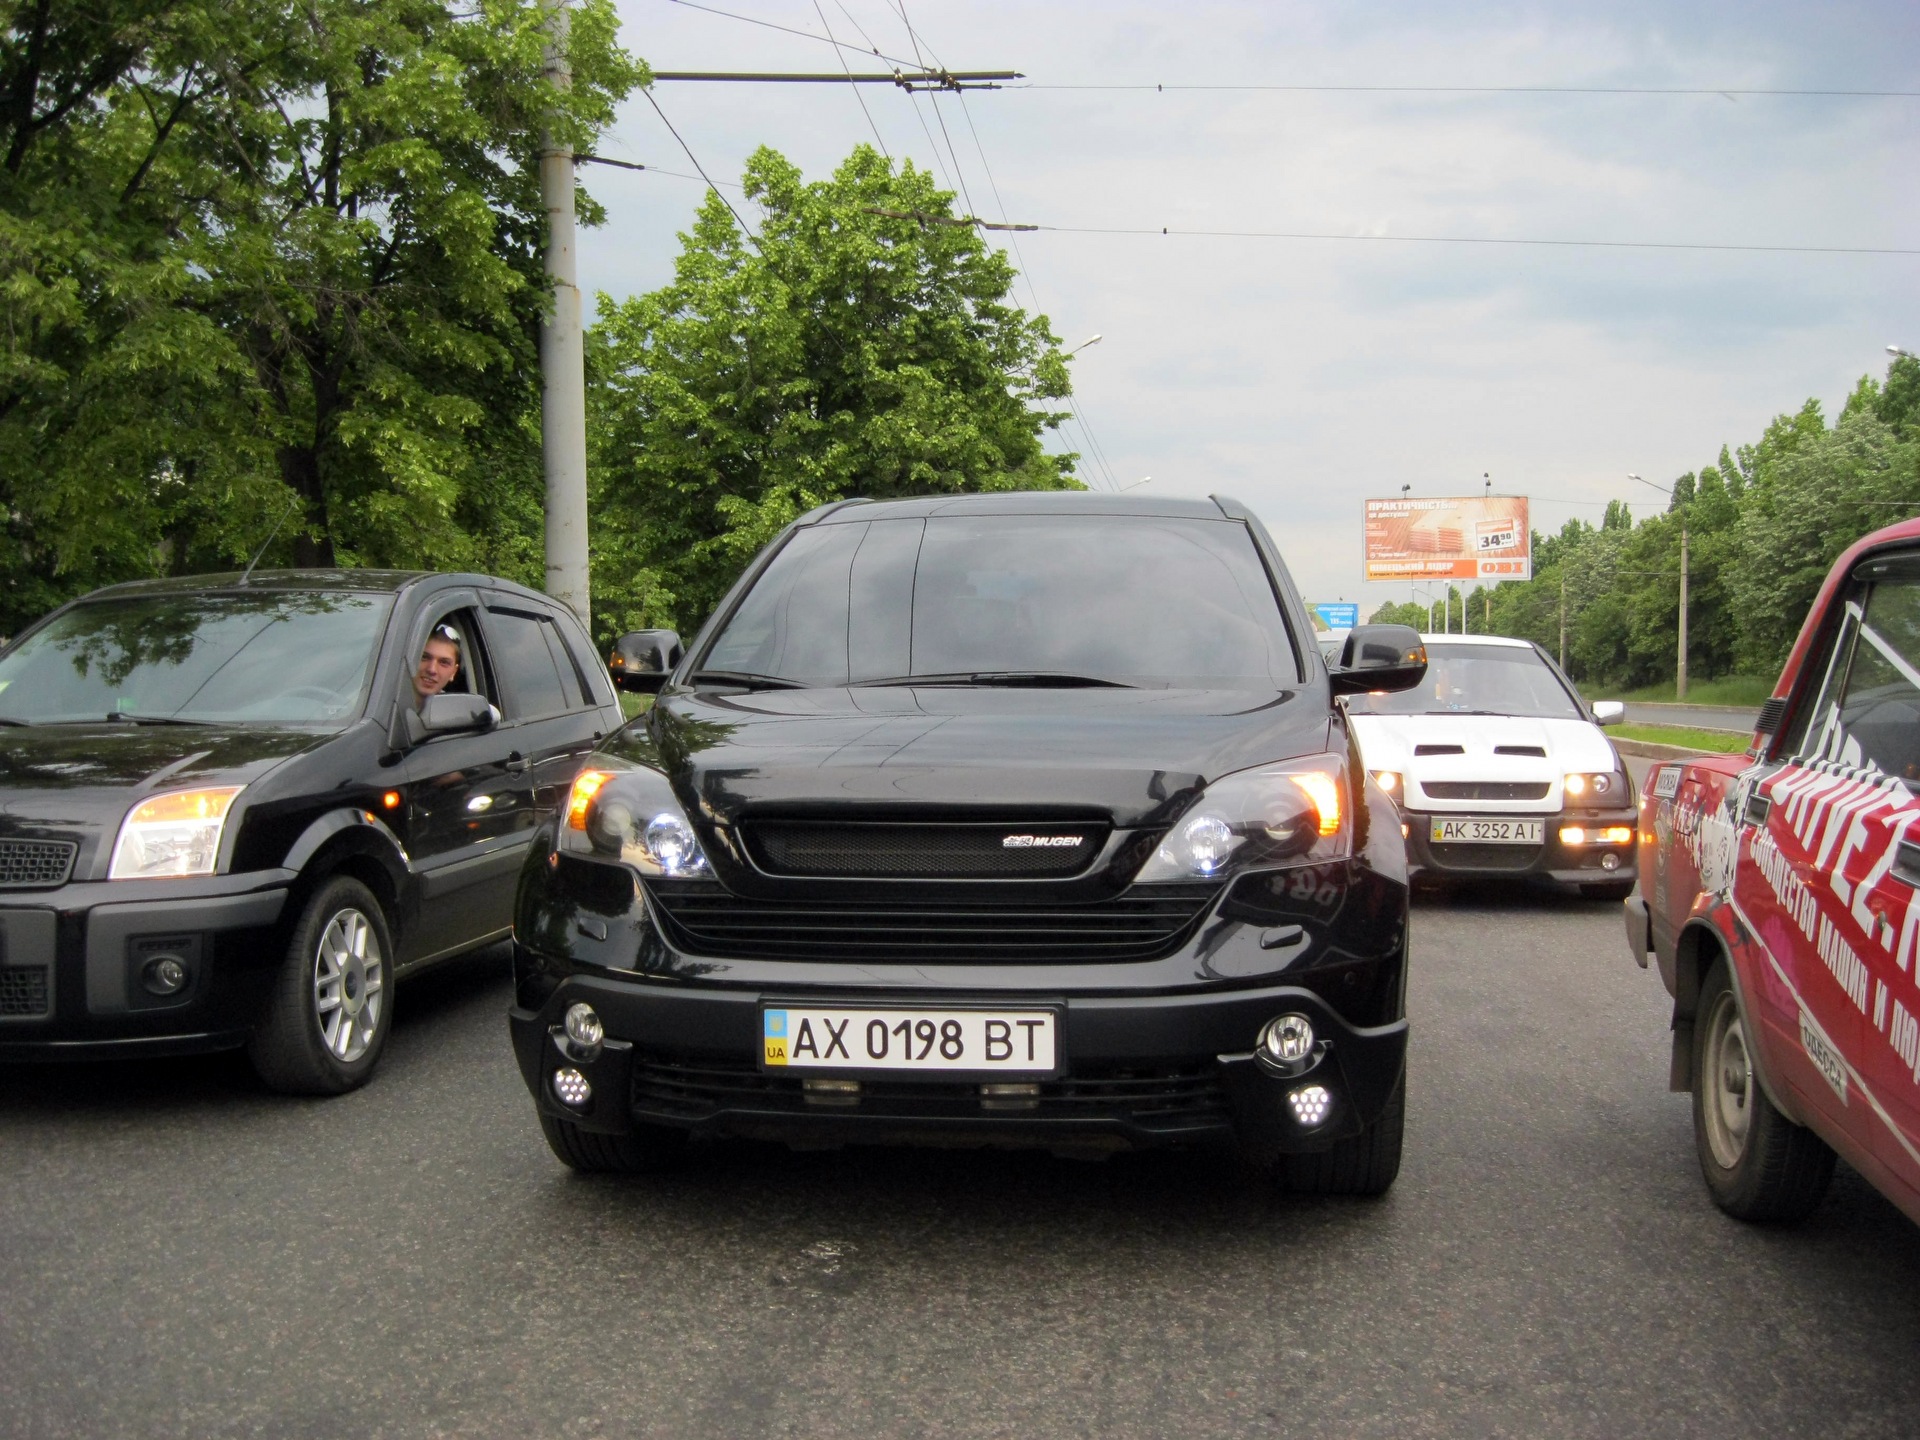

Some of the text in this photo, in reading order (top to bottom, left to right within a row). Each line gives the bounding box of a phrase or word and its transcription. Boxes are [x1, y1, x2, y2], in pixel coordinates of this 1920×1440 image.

[1480, 534, 1501, 548] 34
[1481, 562, 1523, 573] OBI
[1443, 823, 1467, 838] AK
[1472, 823, 1510, 839] 3252
[1033, 836, 1083, 847] MUGEN
[1750, 827, 1920, 1085] СООБЩЕСТВО МАШИН И ЛЮ
[767, 1018, 1045, 1061] UA AX 0198 BT
[1804, 1026, 1843, 1093] ОДЕССА
